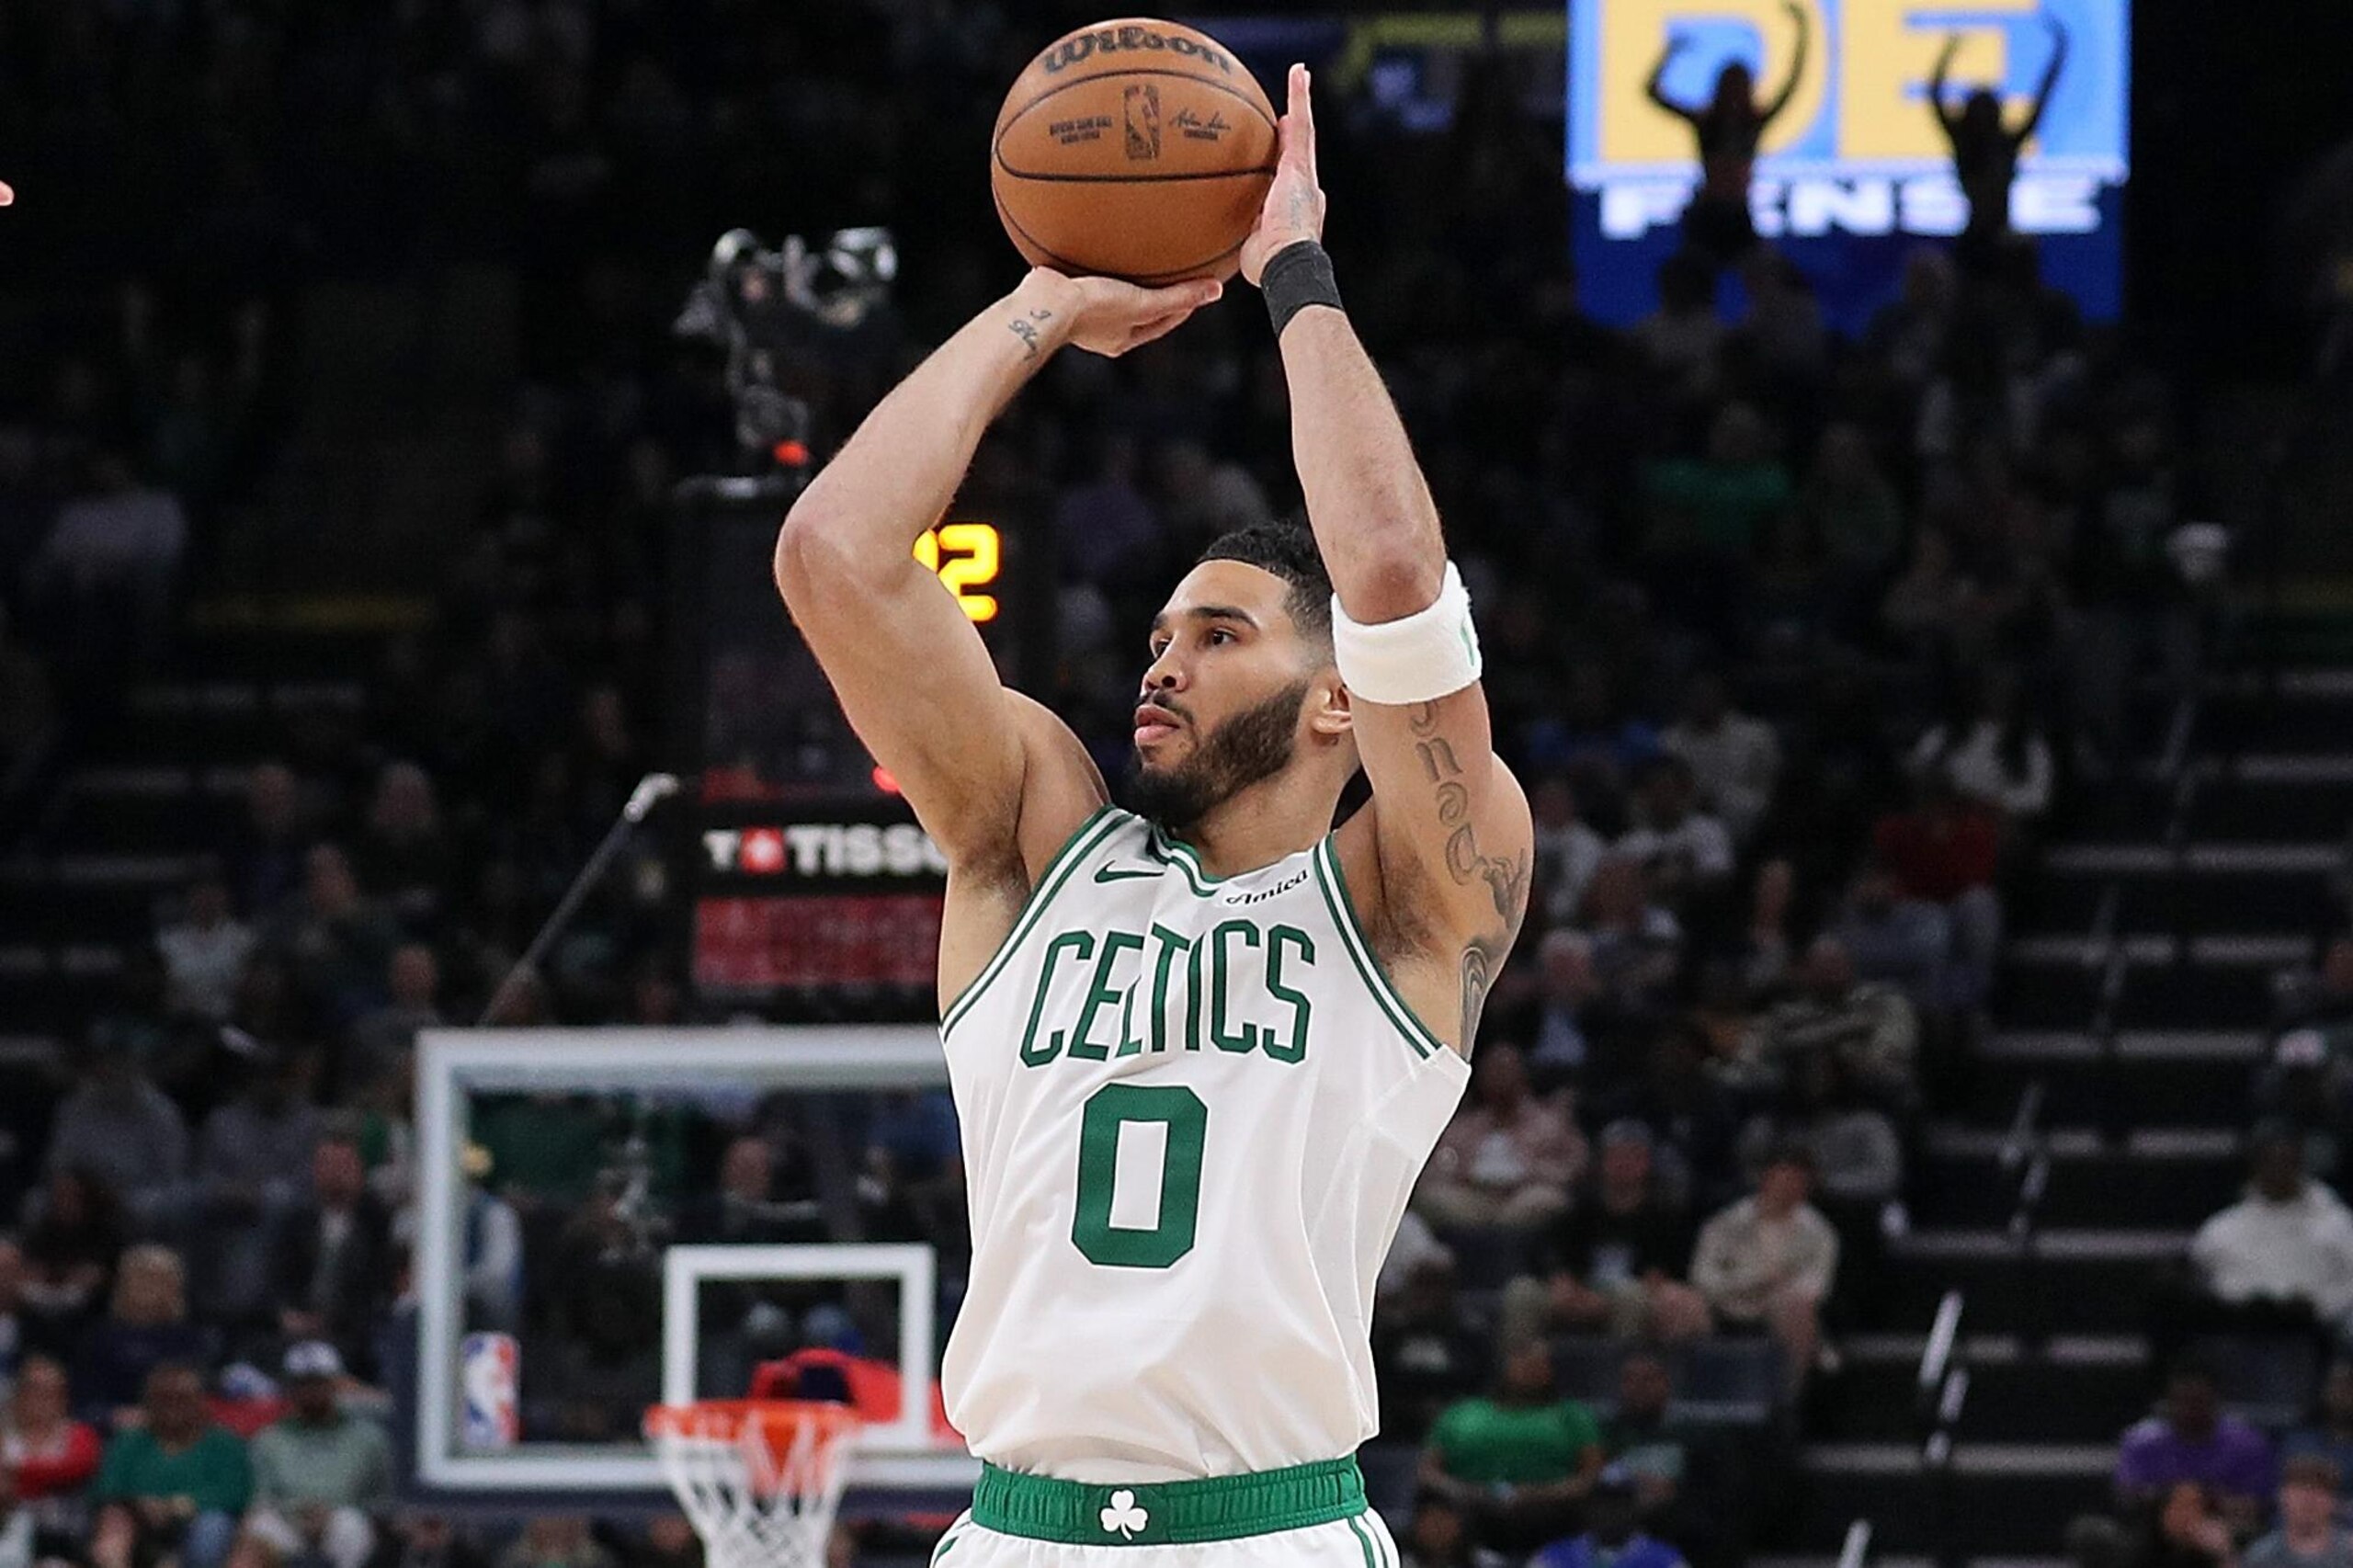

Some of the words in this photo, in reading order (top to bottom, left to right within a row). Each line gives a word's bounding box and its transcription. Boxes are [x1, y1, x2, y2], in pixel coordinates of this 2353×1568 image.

[1045, 27, 1231, 74] Wilson
[1225, 869, 1308, 905] Amica
[1019, 919, 1316, 1068] CELTICS
[1071, 1082, 1209, 1269] 0
